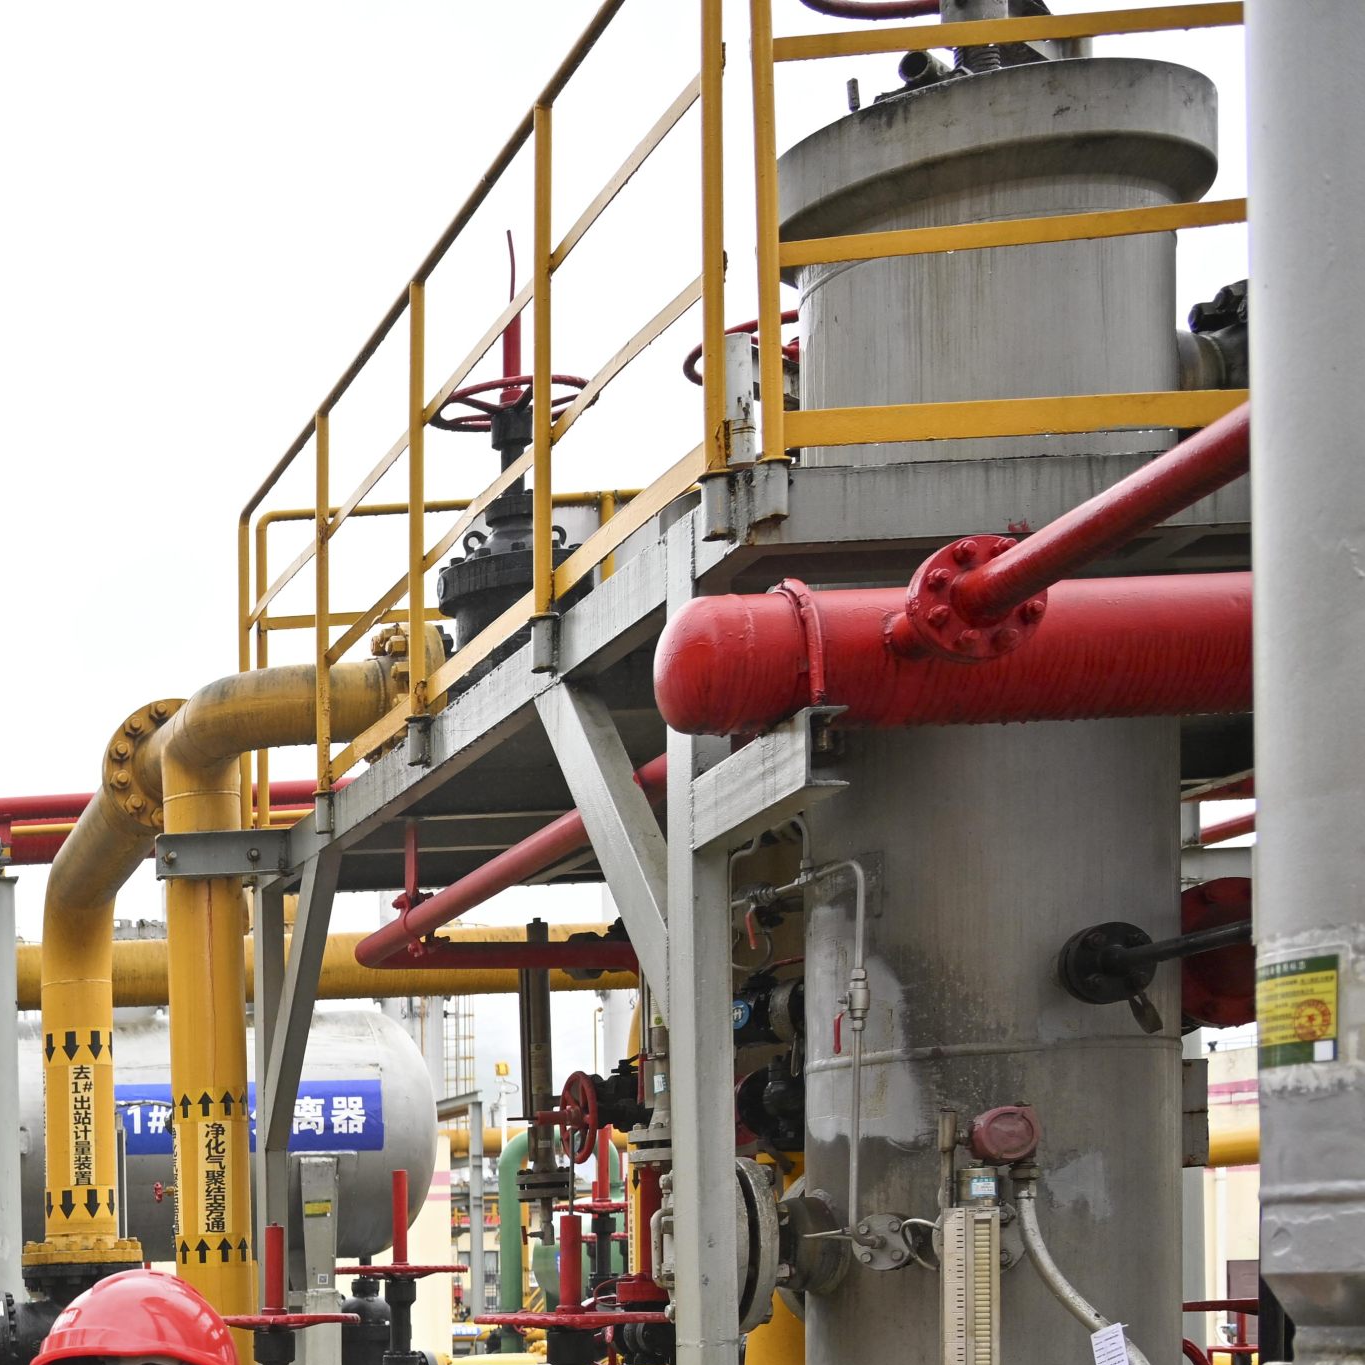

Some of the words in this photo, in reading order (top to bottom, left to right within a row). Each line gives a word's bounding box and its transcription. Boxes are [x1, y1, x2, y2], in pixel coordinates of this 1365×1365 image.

[71, 1065, 93, 1186] 去1#出站计量装置
[204, 1122, 226, 1233] 净化气聚结旁通
